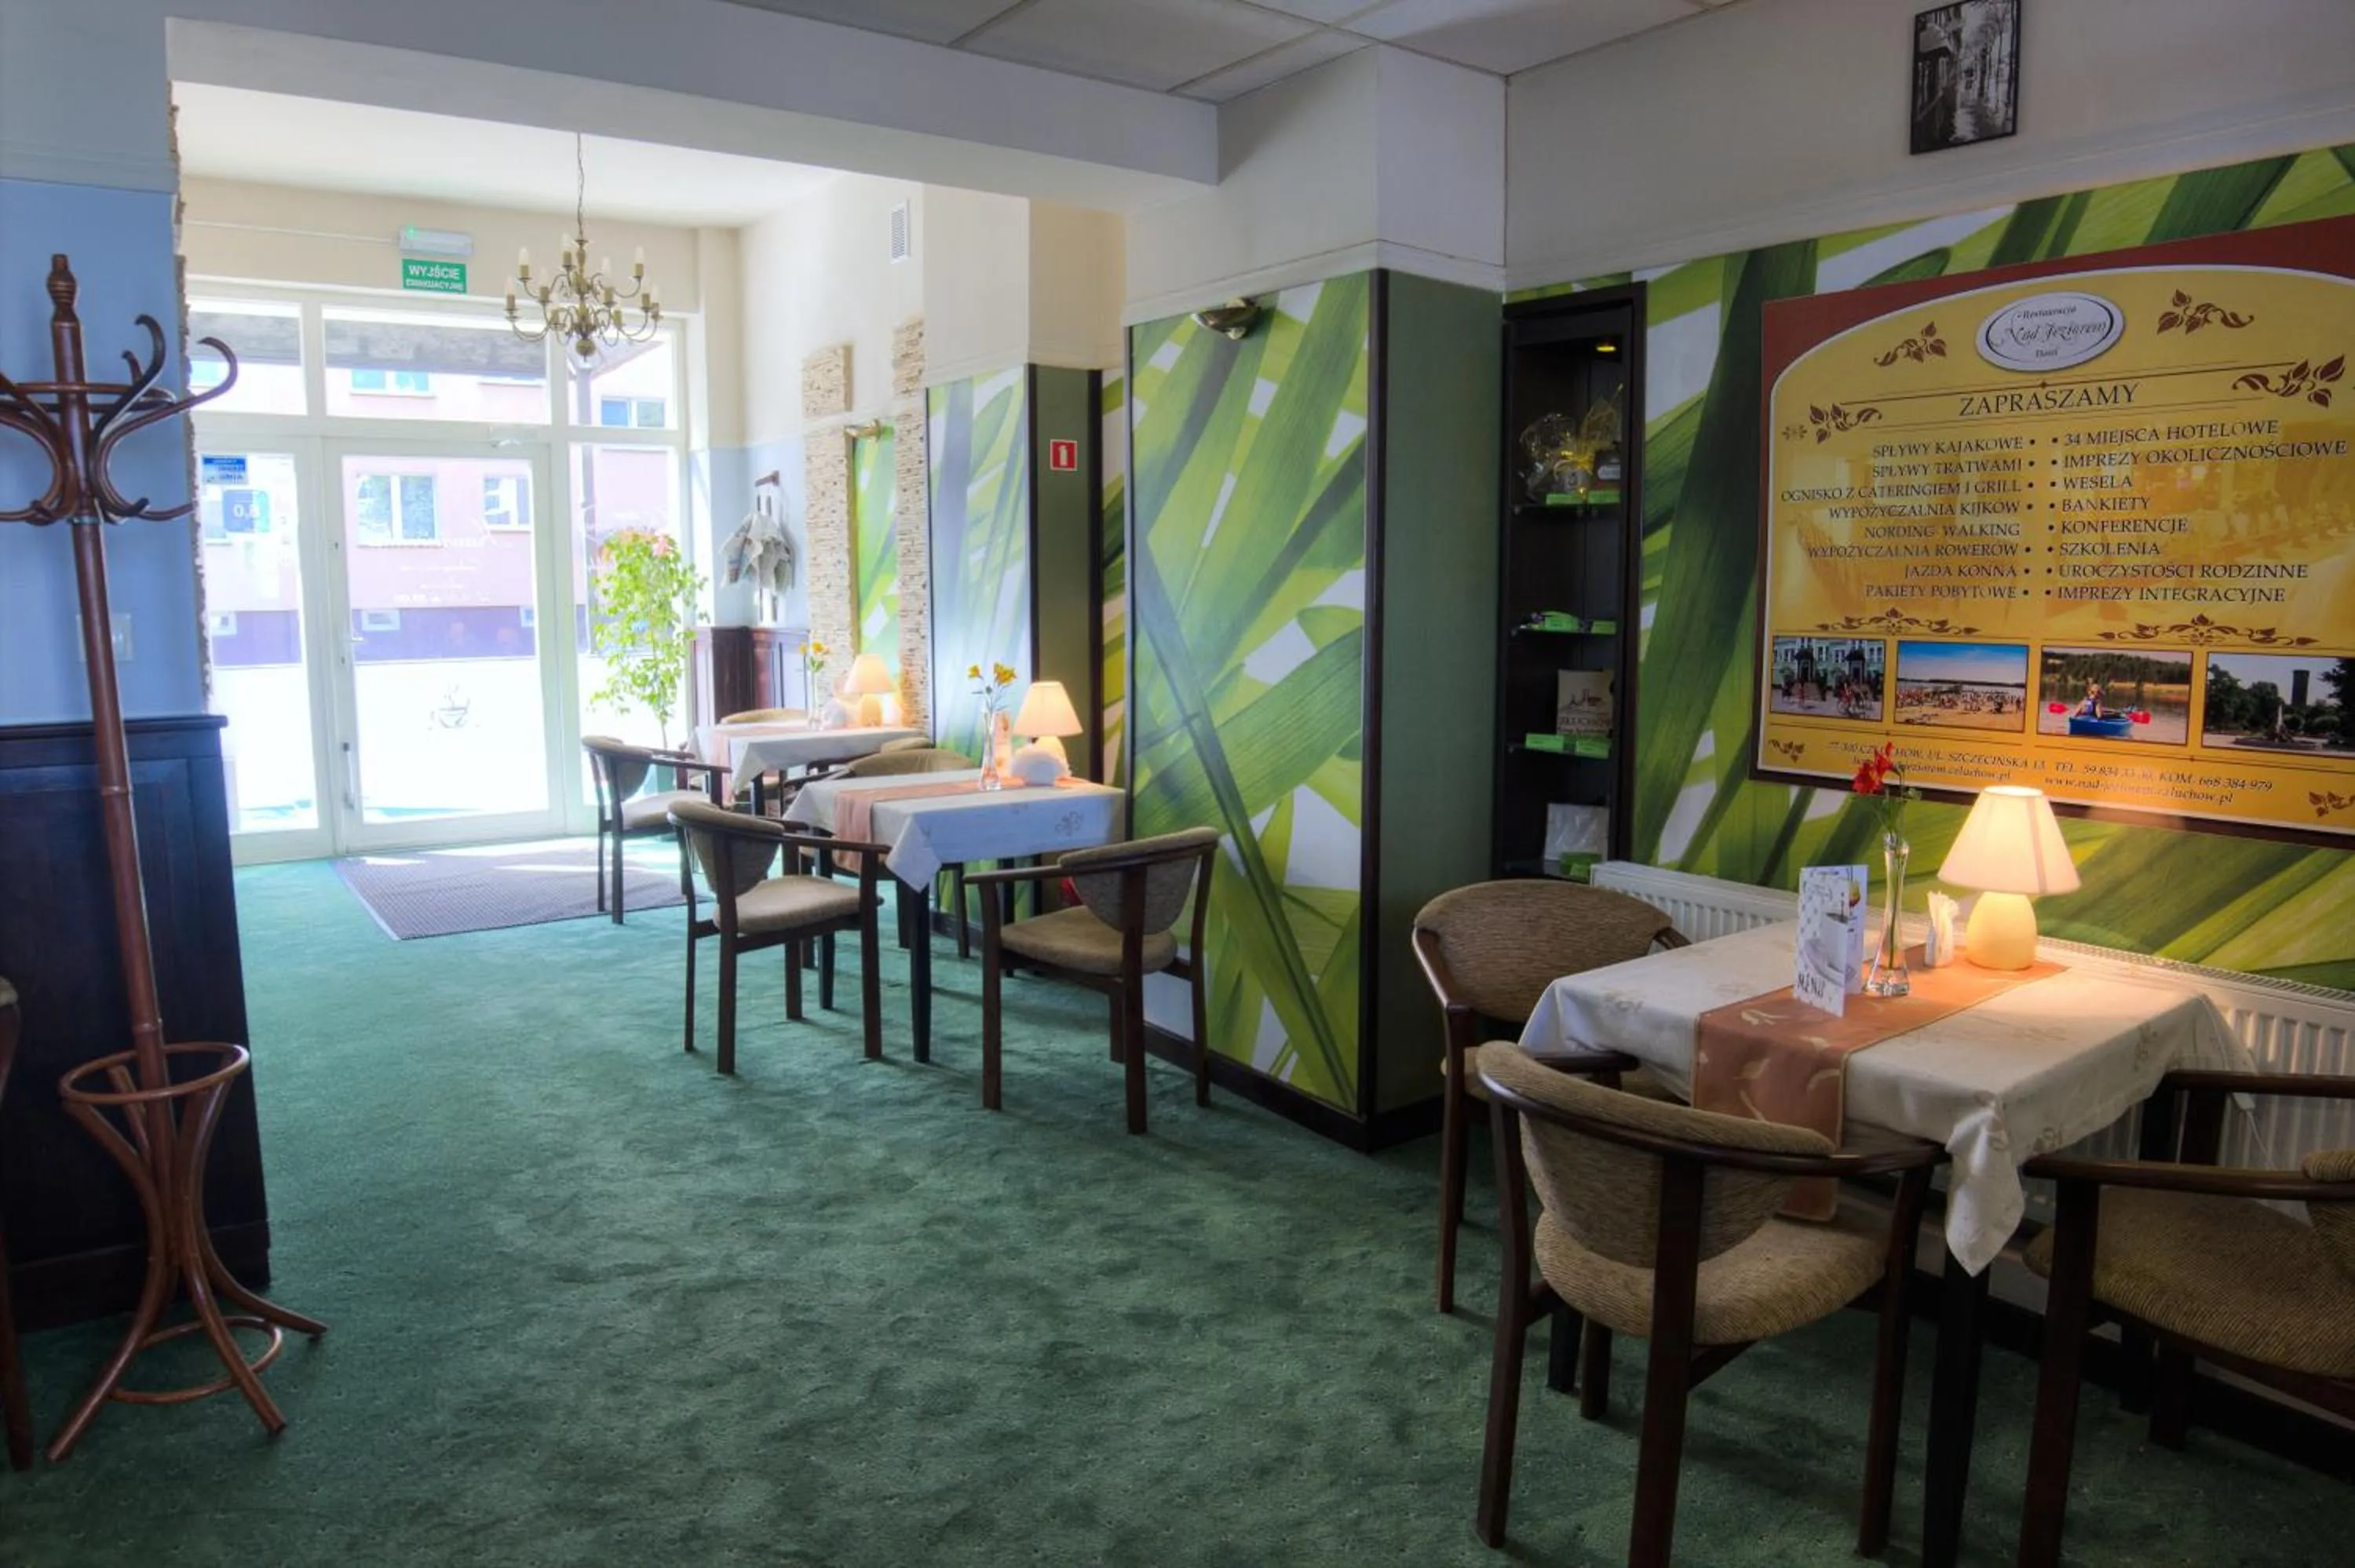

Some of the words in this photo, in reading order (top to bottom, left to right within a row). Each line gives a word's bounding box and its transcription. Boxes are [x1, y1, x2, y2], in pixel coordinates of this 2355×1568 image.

[408, 264, 460, 279] WYJŚCIE
[1959, 383, 2140, 418] ZAPRASZAMY
[2064, 433, 2081, 447] 34
[2087, 428, 2160, 446] MIEJSCA
[2167, 419, 2280, 440] HOTELOWE
[2063, 451, 2141, 469] IMPREZY
[2146, 440, 2348, 464] OKOLICZNOŚCIOWE
[1935, 458, 2022, 474] TRATWAMI
[2063, 475, 2133, 490] WESELA
[1781, 487, 1842, 503] OGNISKO
[1845, 487, 1856, 499] Z
[1858, 483, 1960, 501] CATERINGIEM
[1973, 480, 2022, 494] GRILL
[2062, 496, 2150, 512] BANKIETY
[1865, 526, 1935, 539] NORDING
[1943, 523, 2020, 538] WALKING
[2061, 518, 2189, 534] KONFERENCJE
[2059, 542, 2160, 556] SZKOLENIA
[1904, 564, 1952, 578] JAZDA
[1958, 563, 2017, 578] KONNA
[2199, 563, 2309, 578] RODZINNE
[1866, 585, 1926, 597] PAKIETY
[1931, 585, 2017, 599] POBYTOWE
[2058, 587, 2134, 600] IMPREZY
[2139, 587, 2285, 605] INTEGRACYJNE
